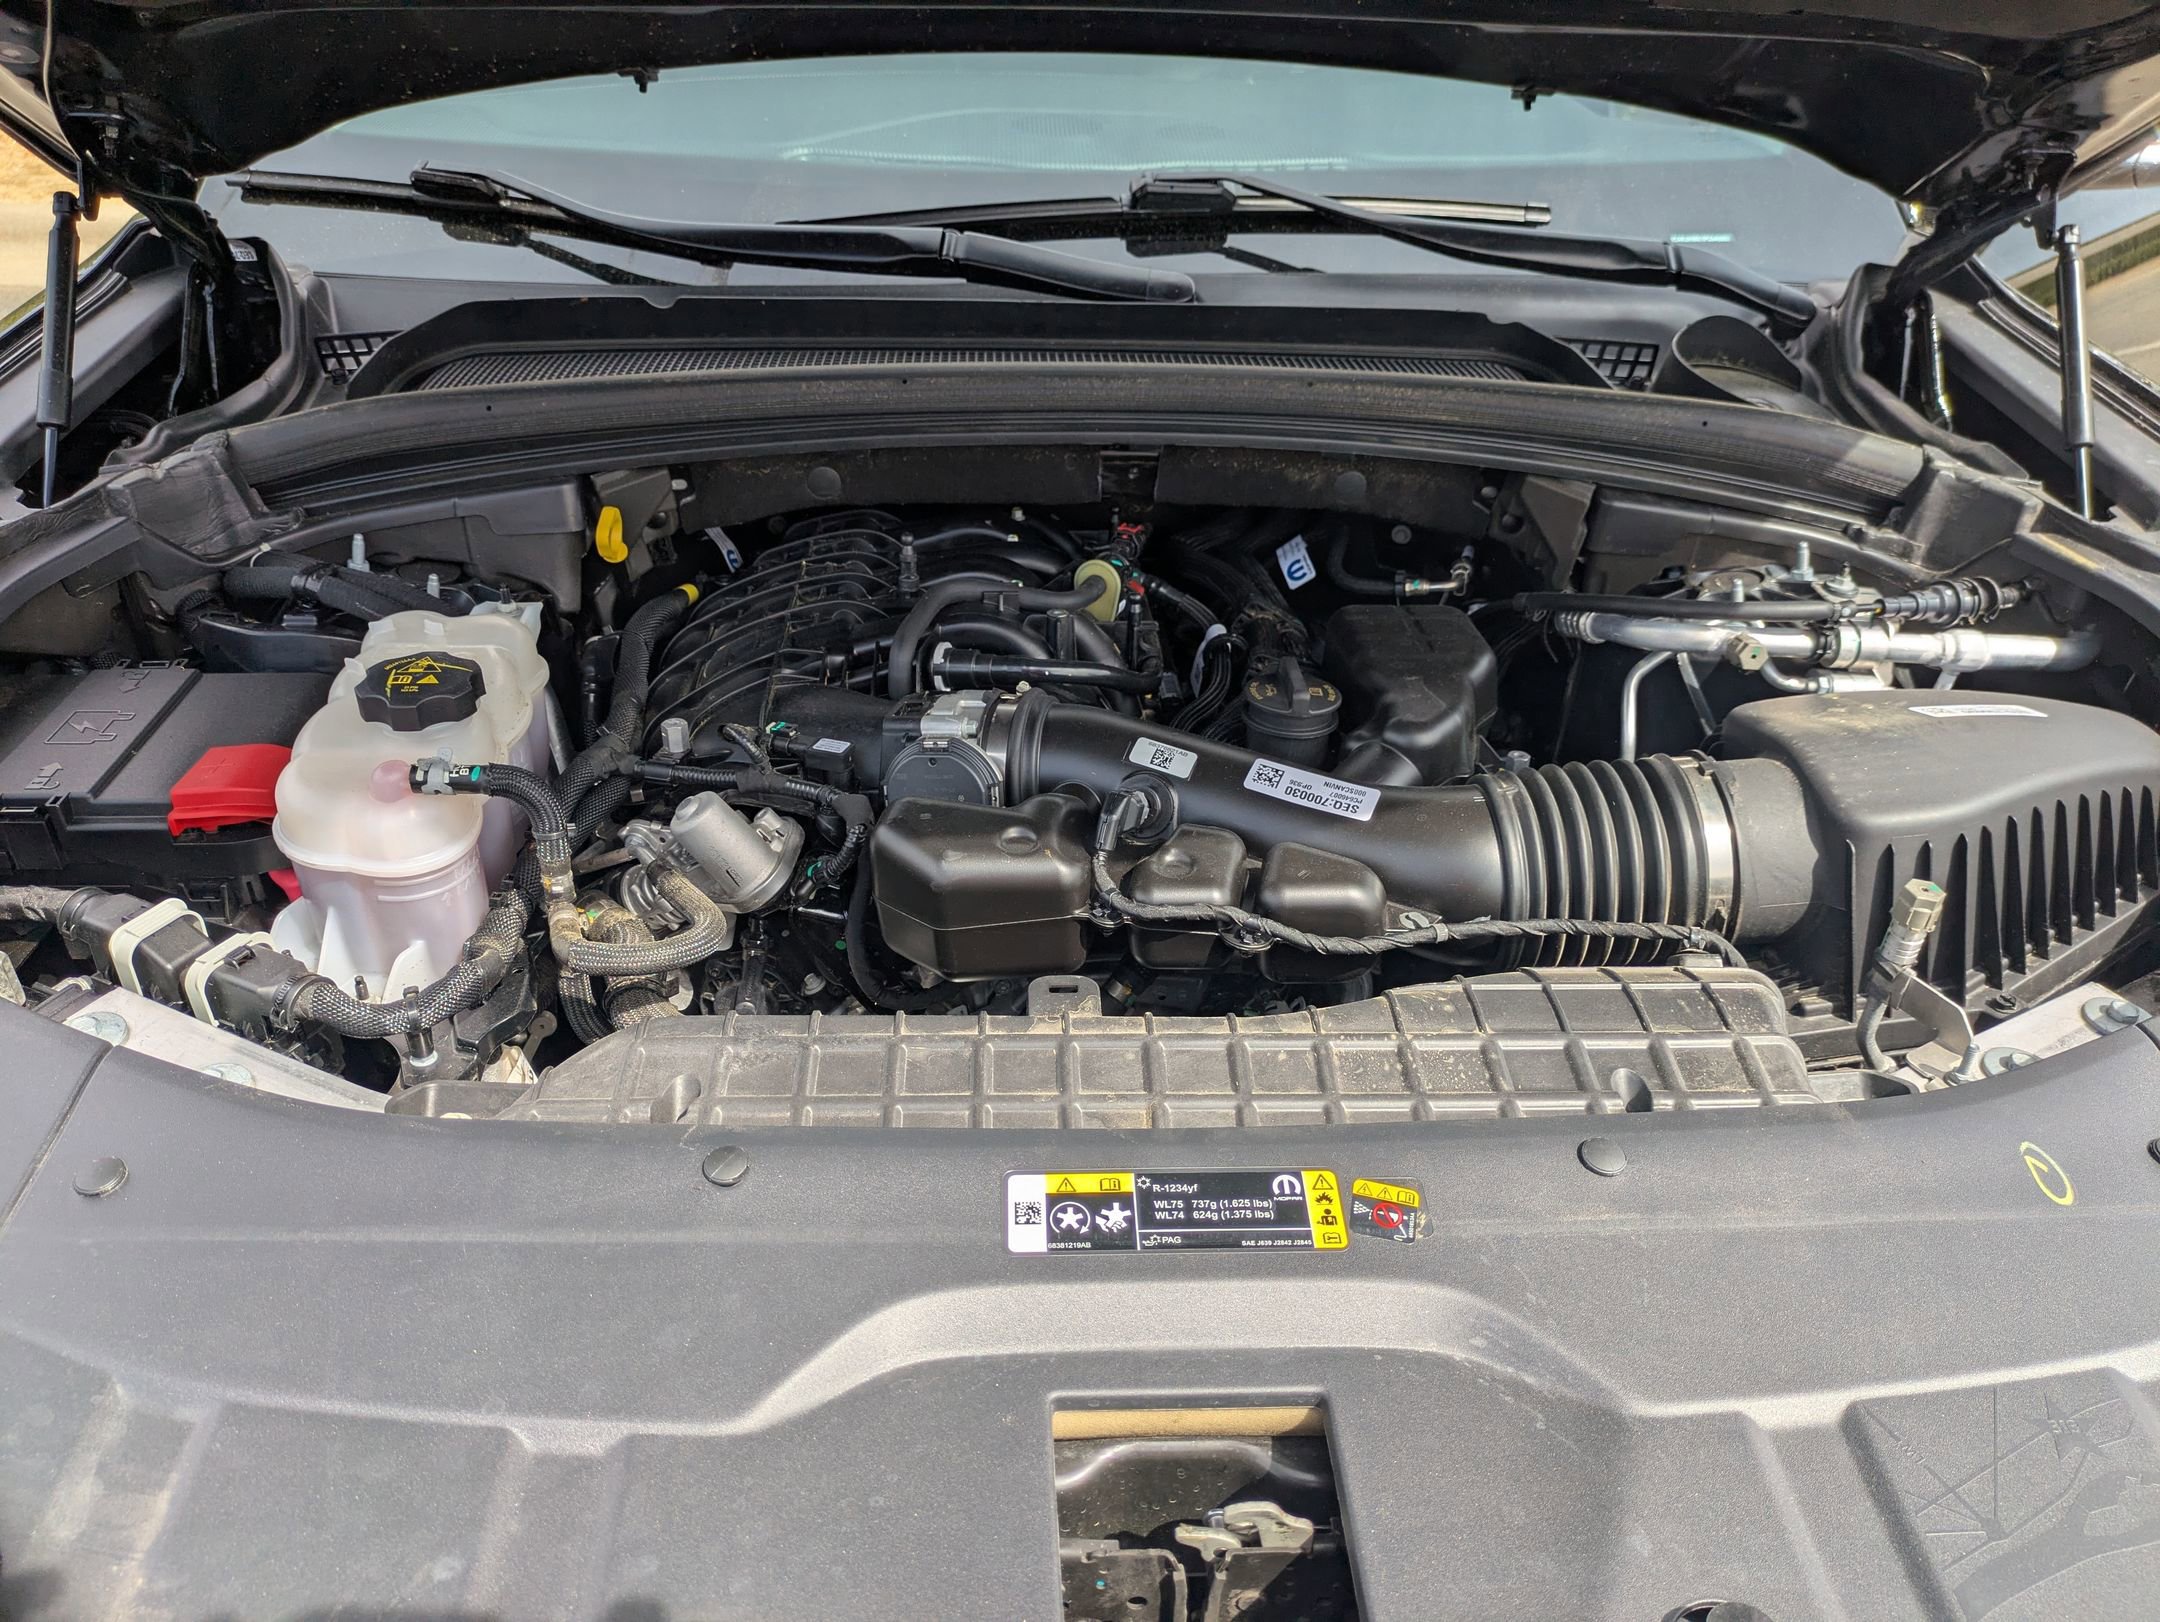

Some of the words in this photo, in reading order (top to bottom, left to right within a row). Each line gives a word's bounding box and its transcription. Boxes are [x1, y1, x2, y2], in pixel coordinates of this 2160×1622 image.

[1284, 785, 1360, 814] SEQ:700030
[1152, 1184, 1198, 1194] R-1234yf
[1153, 1200, 1184, 1209] WL75
[1191, 1200, 1217, 1210] 737g
[1219, 1199, 1251, 1209] (1.625
[1253, 1199, 1273, 1209] lbs)
[1154, 1211, 1185, 1219] WL74
[1193, 1211, 1218, 1220] 624g
[1221, 1210, 1252, 1220] (1.375
[1255, 1210, 1275, 1220] lbs)
[1162, 1236, 1182, 1244] PAG
